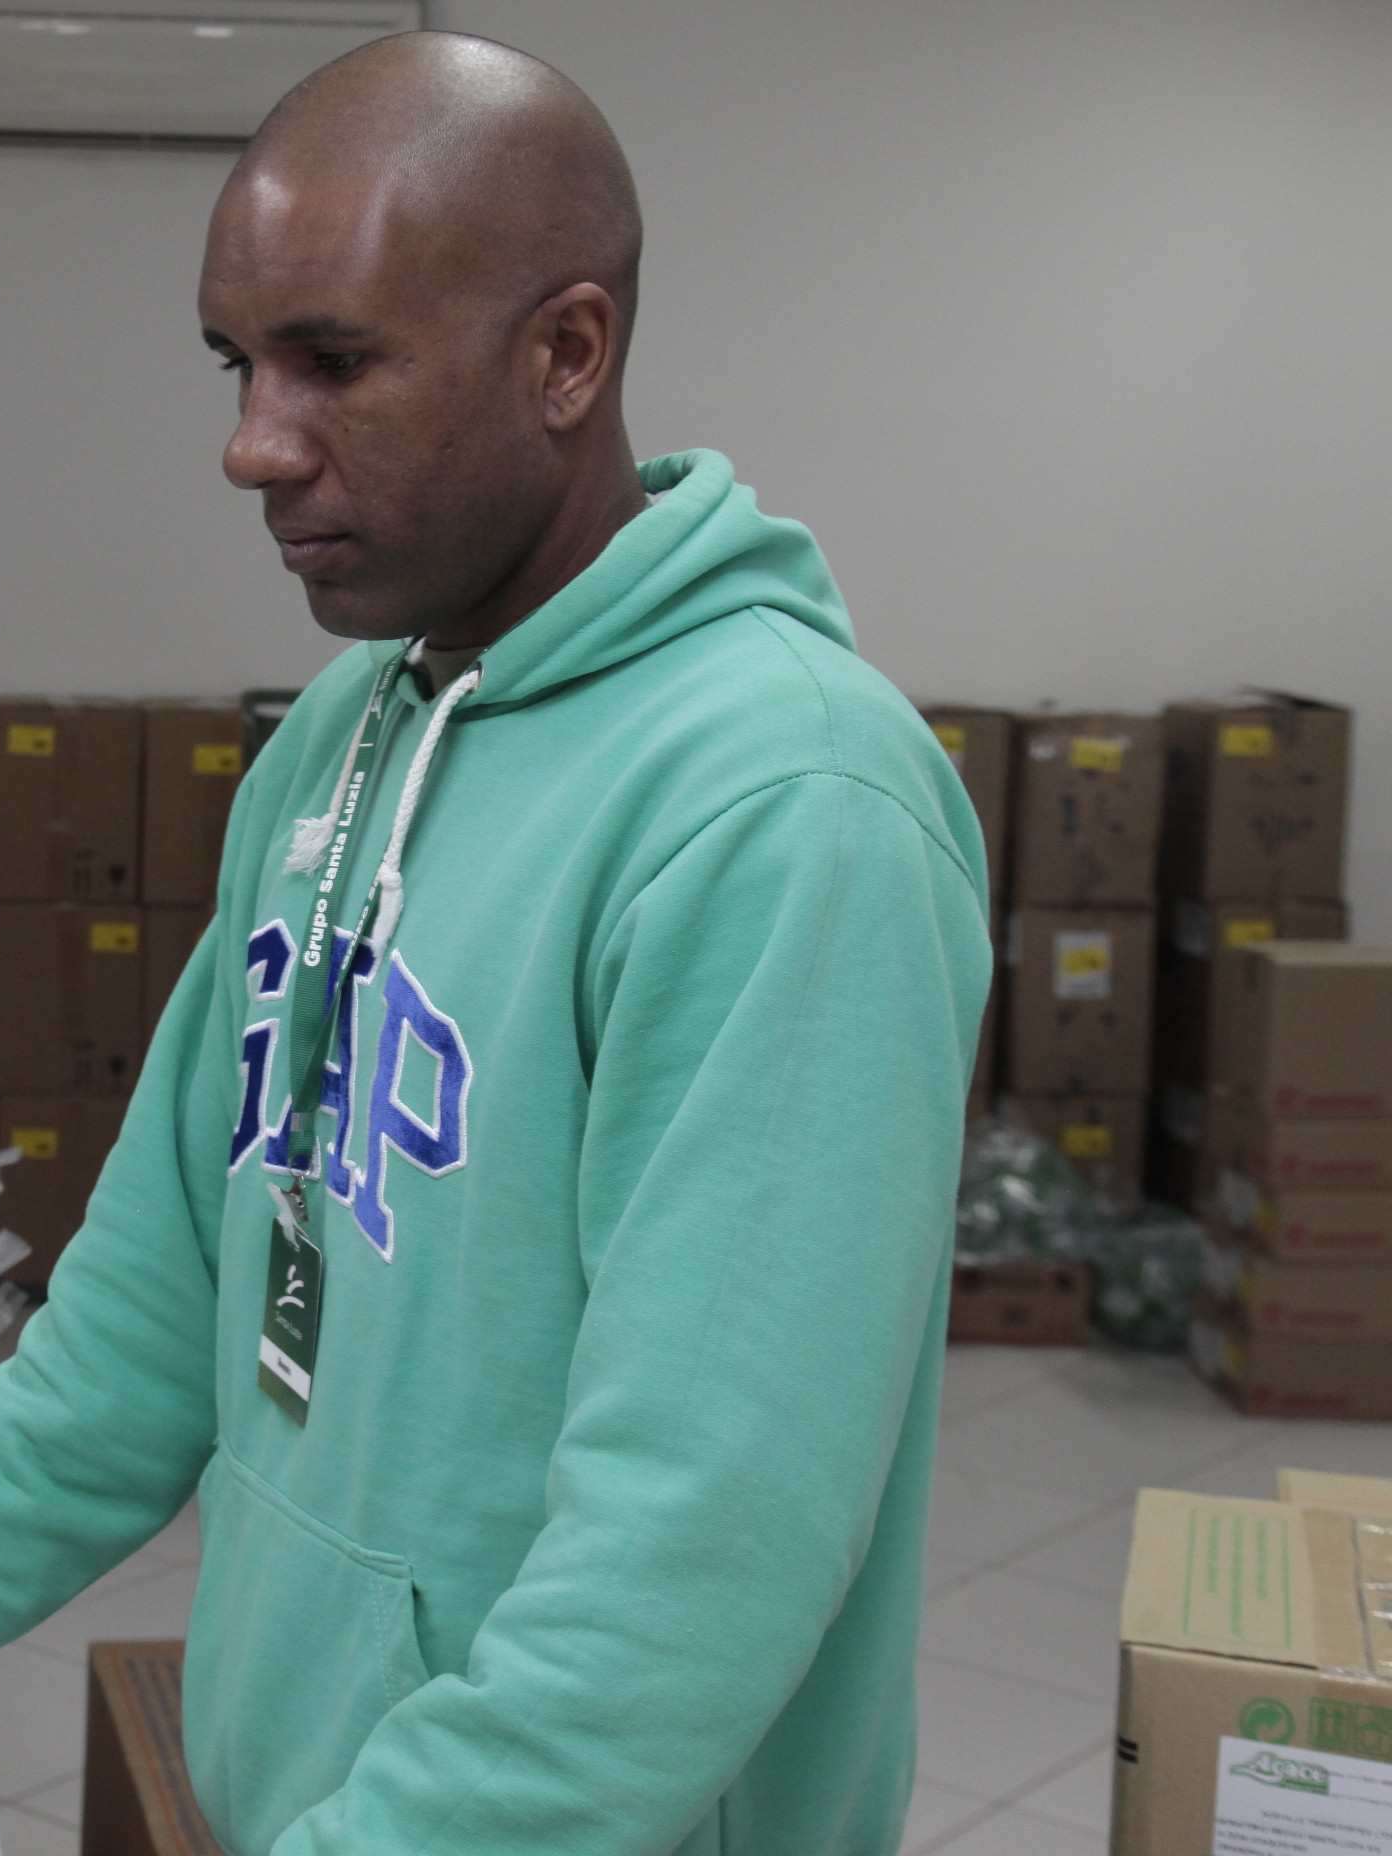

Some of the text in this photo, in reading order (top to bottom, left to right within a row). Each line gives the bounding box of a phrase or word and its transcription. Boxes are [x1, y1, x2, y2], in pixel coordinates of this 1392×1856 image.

[304, 771, 365, 967] Grupo Santa Luzia
